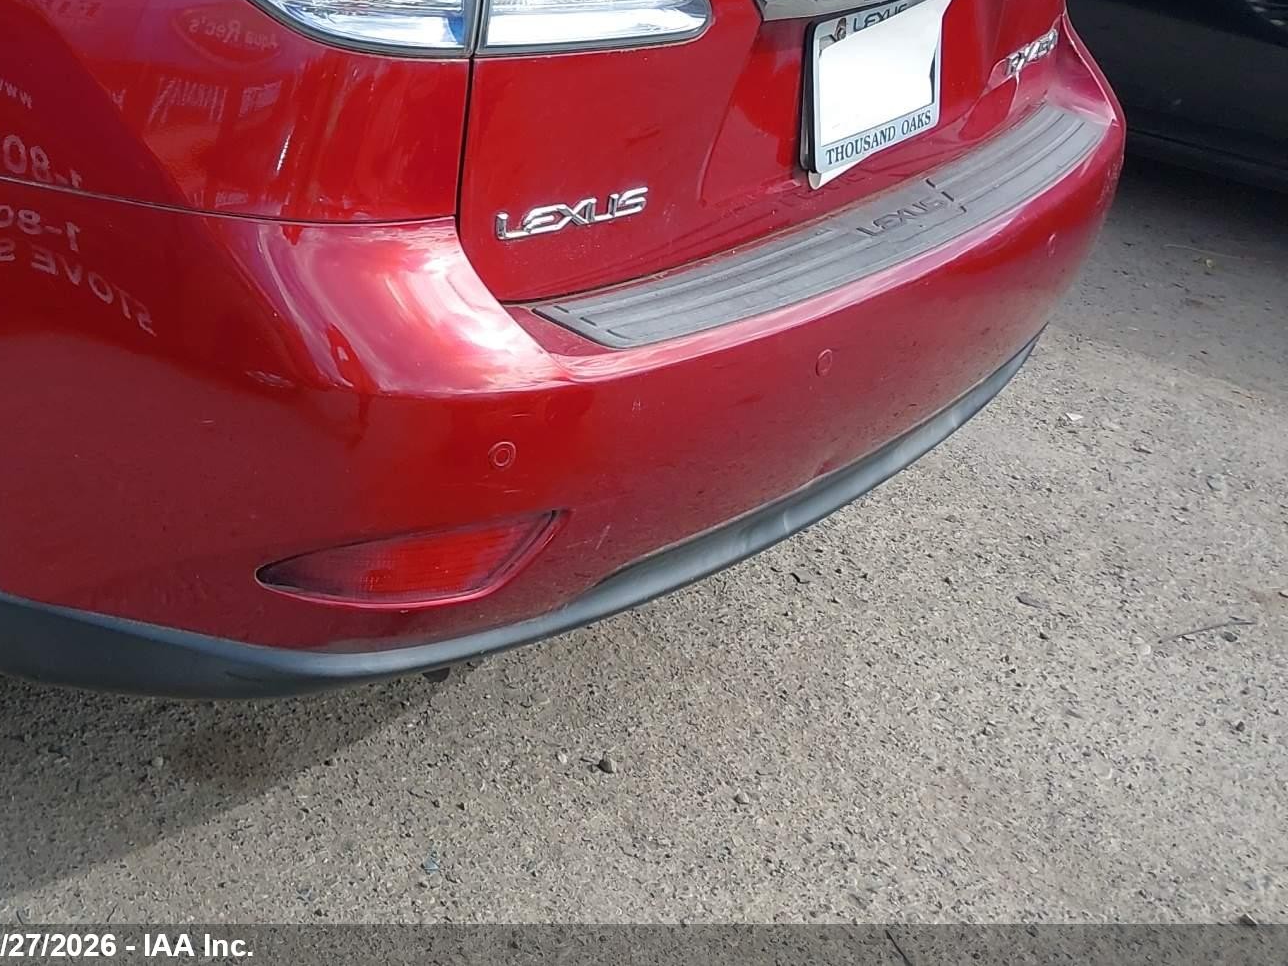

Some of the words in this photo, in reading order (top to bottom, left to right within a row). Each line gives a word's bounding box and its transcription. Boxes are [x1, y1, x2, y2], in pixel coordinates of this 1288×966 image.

[825, 125, 896, 166] THOUSAND
[901, 109, 932, 136] OAKS
[496, 186, 649, 240] LEXUS
